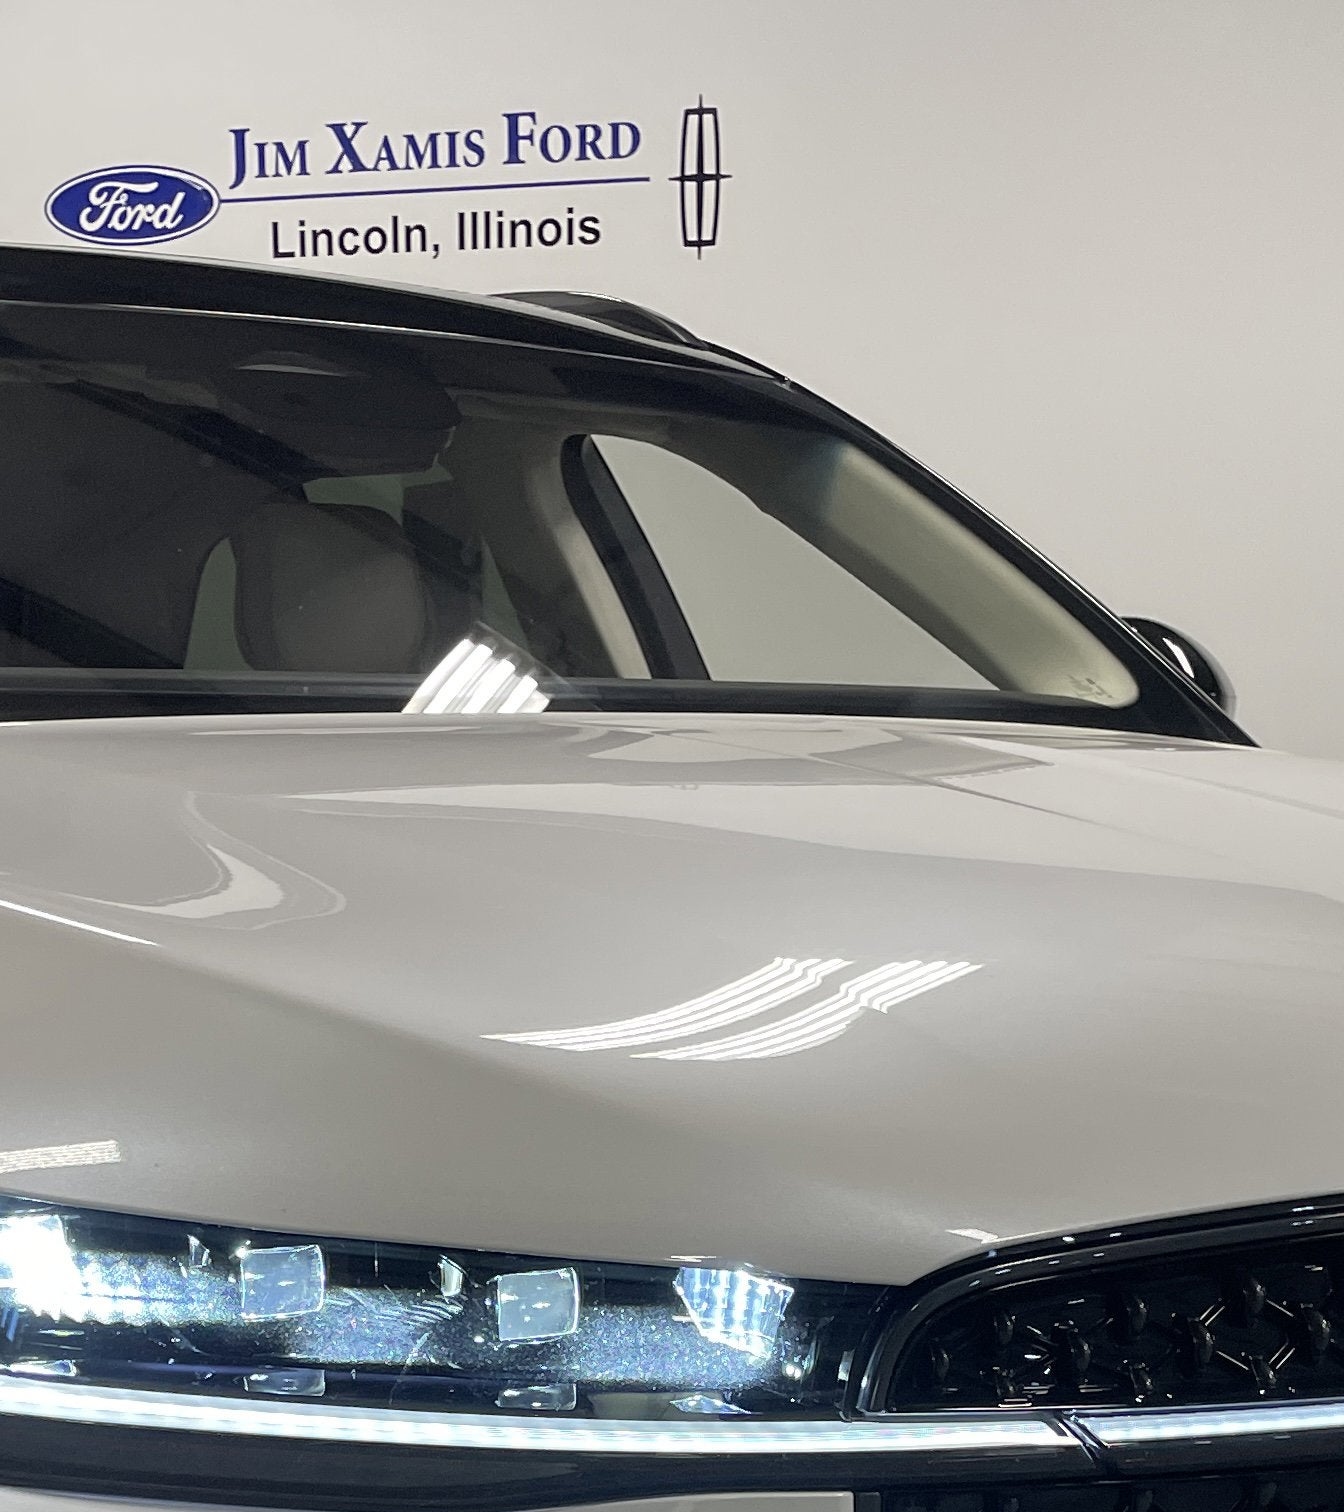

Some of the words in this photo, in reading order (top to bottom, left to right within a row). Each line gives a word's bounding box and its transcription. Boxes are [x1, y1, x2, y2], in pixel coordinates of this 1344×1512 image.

[229, 128, 311, 190] JIM
[324, 121, 485, 174] XAMIS
[502, 111, 641, 165] FORD
[79, 180, 185, 234] Ford
[271, 215, 440, 260] Lincoln,
[458, 207, 601, 251] Illinois
